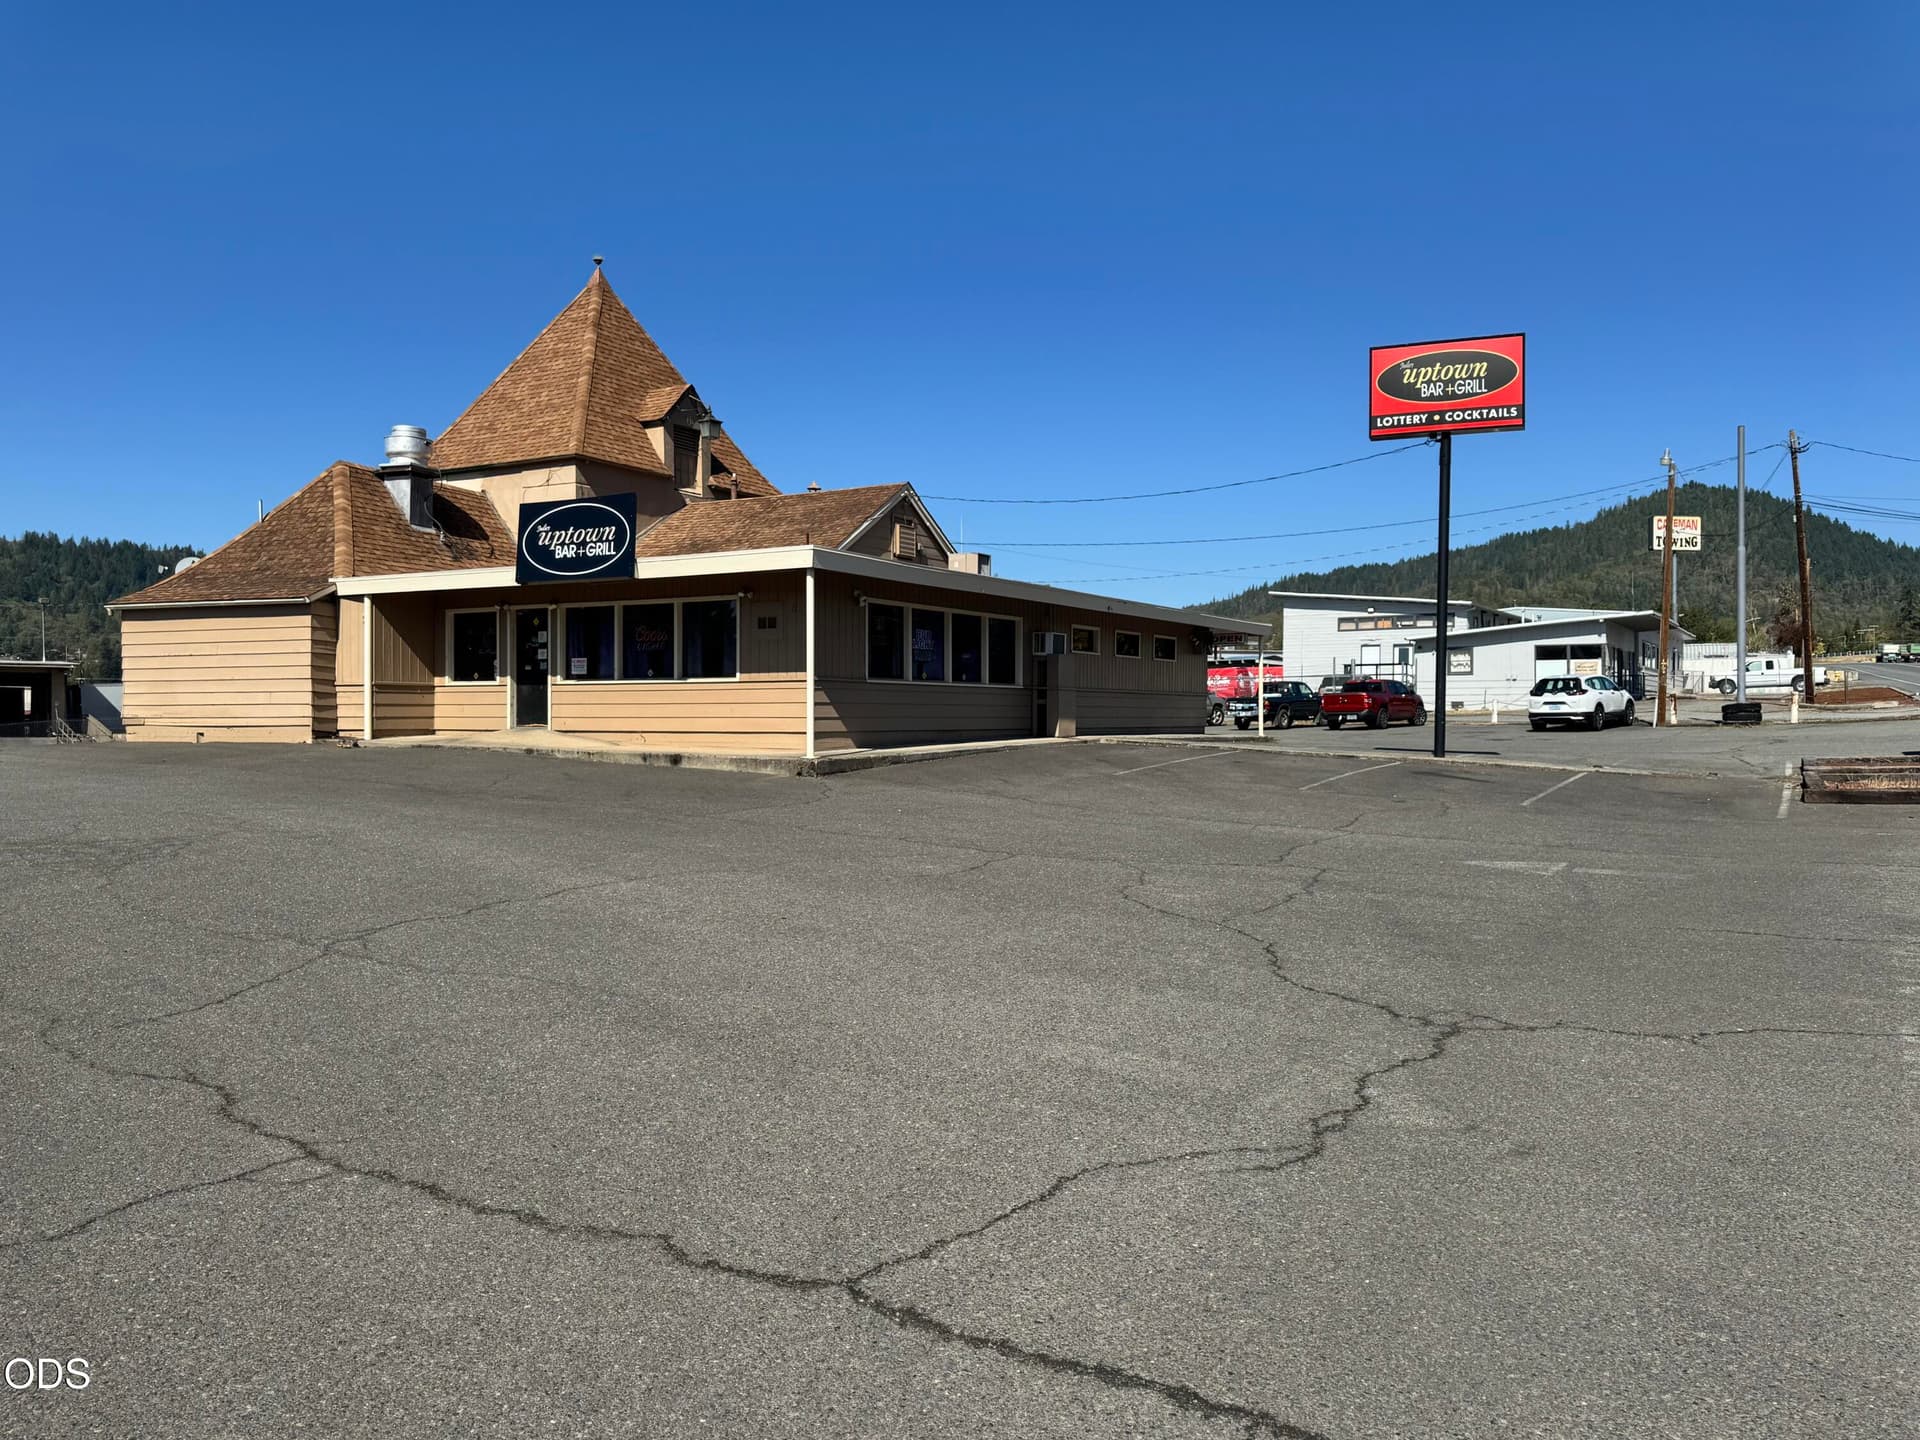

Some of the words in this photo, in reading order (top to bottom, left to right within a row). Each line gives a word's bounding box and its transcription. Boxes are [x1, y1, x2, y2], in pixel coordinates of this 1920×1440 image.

[1402, 361, 1488, 390] uptown
[1377, 413, 1428, 427] LOTTERY
[1445, 407, 1518, 421] COCKTAILS
[1656, 518, 1698, 531] CAEMAN
[538, 525, 616, 550] uptown
